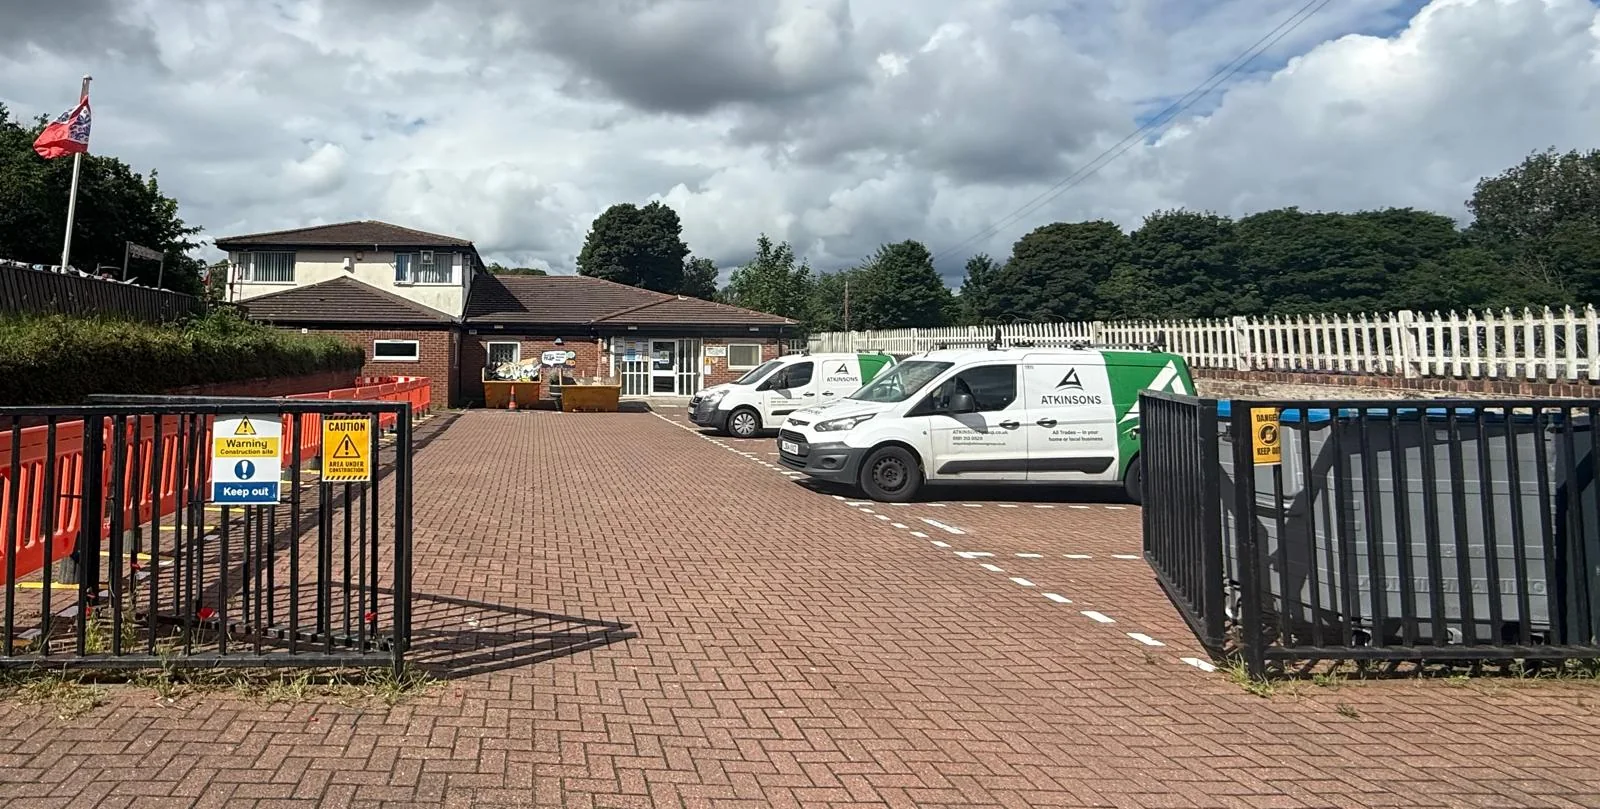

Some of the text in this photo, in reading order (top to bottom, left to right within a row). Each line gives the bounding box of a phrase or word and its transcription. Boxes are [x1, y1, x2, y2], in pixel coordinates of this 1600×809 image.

[1041, 395, 1102, 405] ATKINSONS
[1257, 414, 1278, 422] DANGE
[329, 422, 365, 431] CAUTION
[226, 439, 268, 449] Warning
[1257, 447, 1271, 455] KEEP
[223, 487, 269, 498] Keep out
